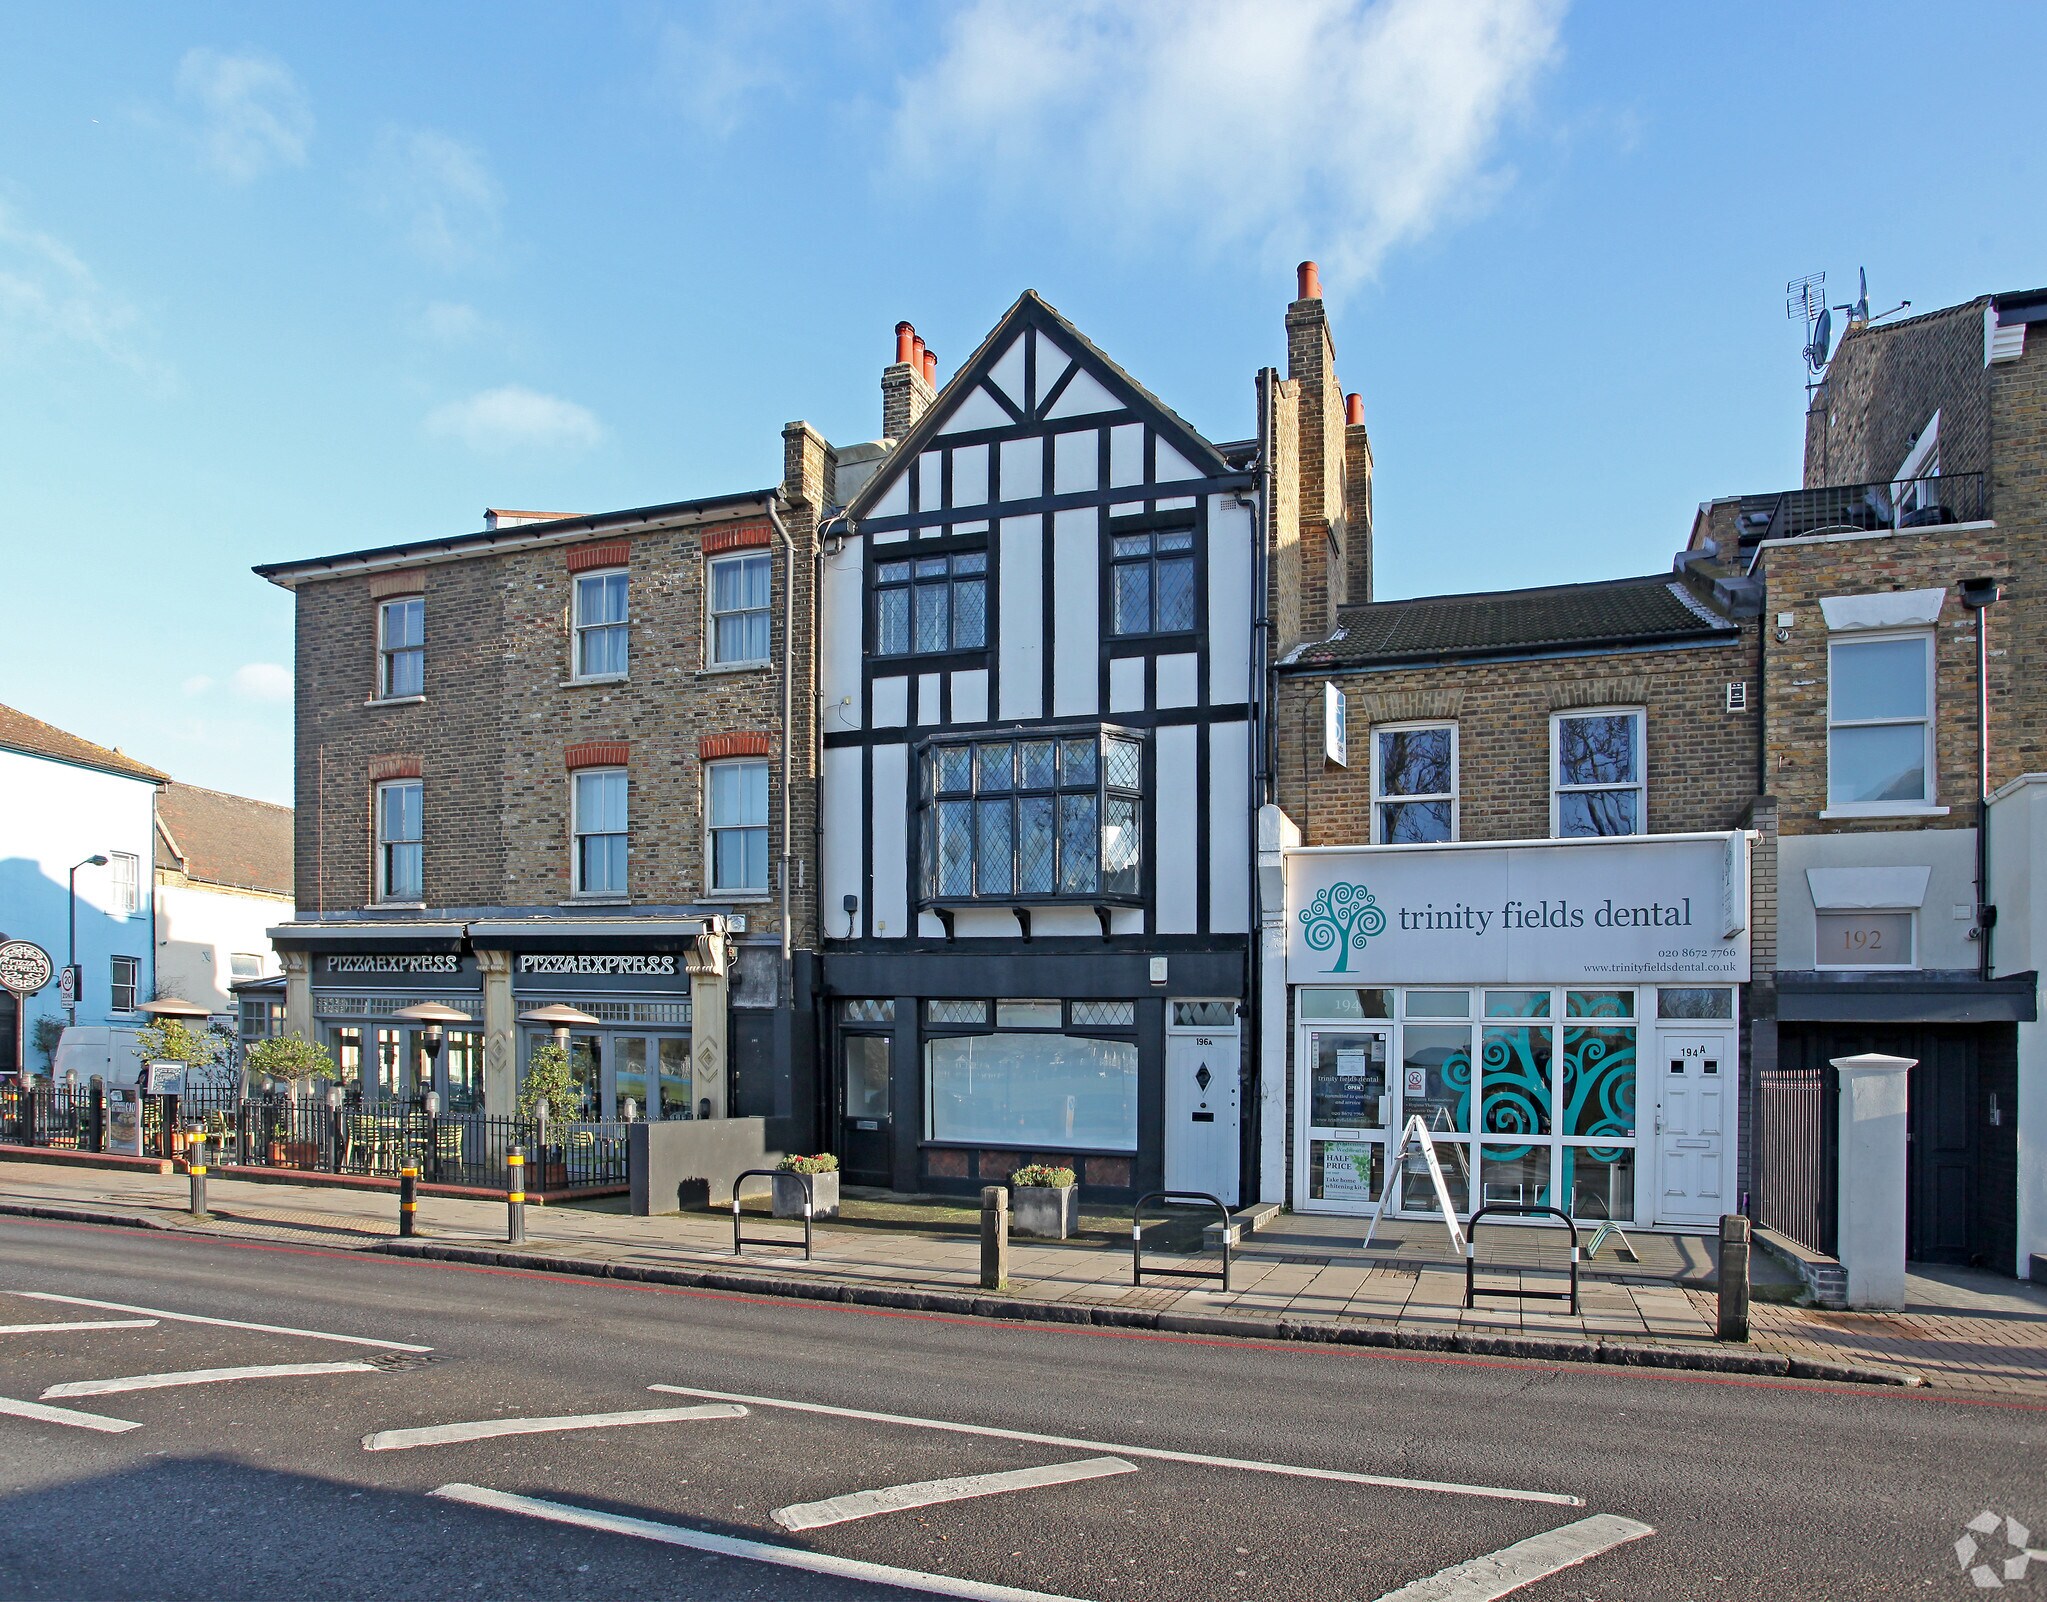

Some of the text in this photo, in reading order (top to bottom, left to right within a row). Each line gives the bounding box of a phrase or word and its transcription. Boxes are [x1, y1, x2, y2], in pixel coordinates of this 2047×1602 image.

[1398, 903, 1494, 936] trinity
[1501, 900, 1584, 929] fields
[1594, 897, 1692, 928] dental
[1844, 930, 1882, 950] 192
[1658, 948, 1736, 959] 020 8672 7766
[1, 963, 45, 974] EXPRESS
[9, 959, 37, 967] PIZZA
[326, 955, 458, 973] PIZZAEXPRESS
[520, 954, 675, 975] PIZZAEXPRESS
[1583, 961, 1737, 974] www.trinityfieldsdental.co.uk
[64, 975, 72, 985] 20
[1335, 999, 1360, 1012] 194
[1195, 1037, 1213, 1046] 196A
[1318, 1075, 1339, 1083] trinity
[1358, 1075, 1379, 1083] dental
[1326, 1154, 1350, 1162] HALF
[1326, 1162, 1353, 1170] PRICE
